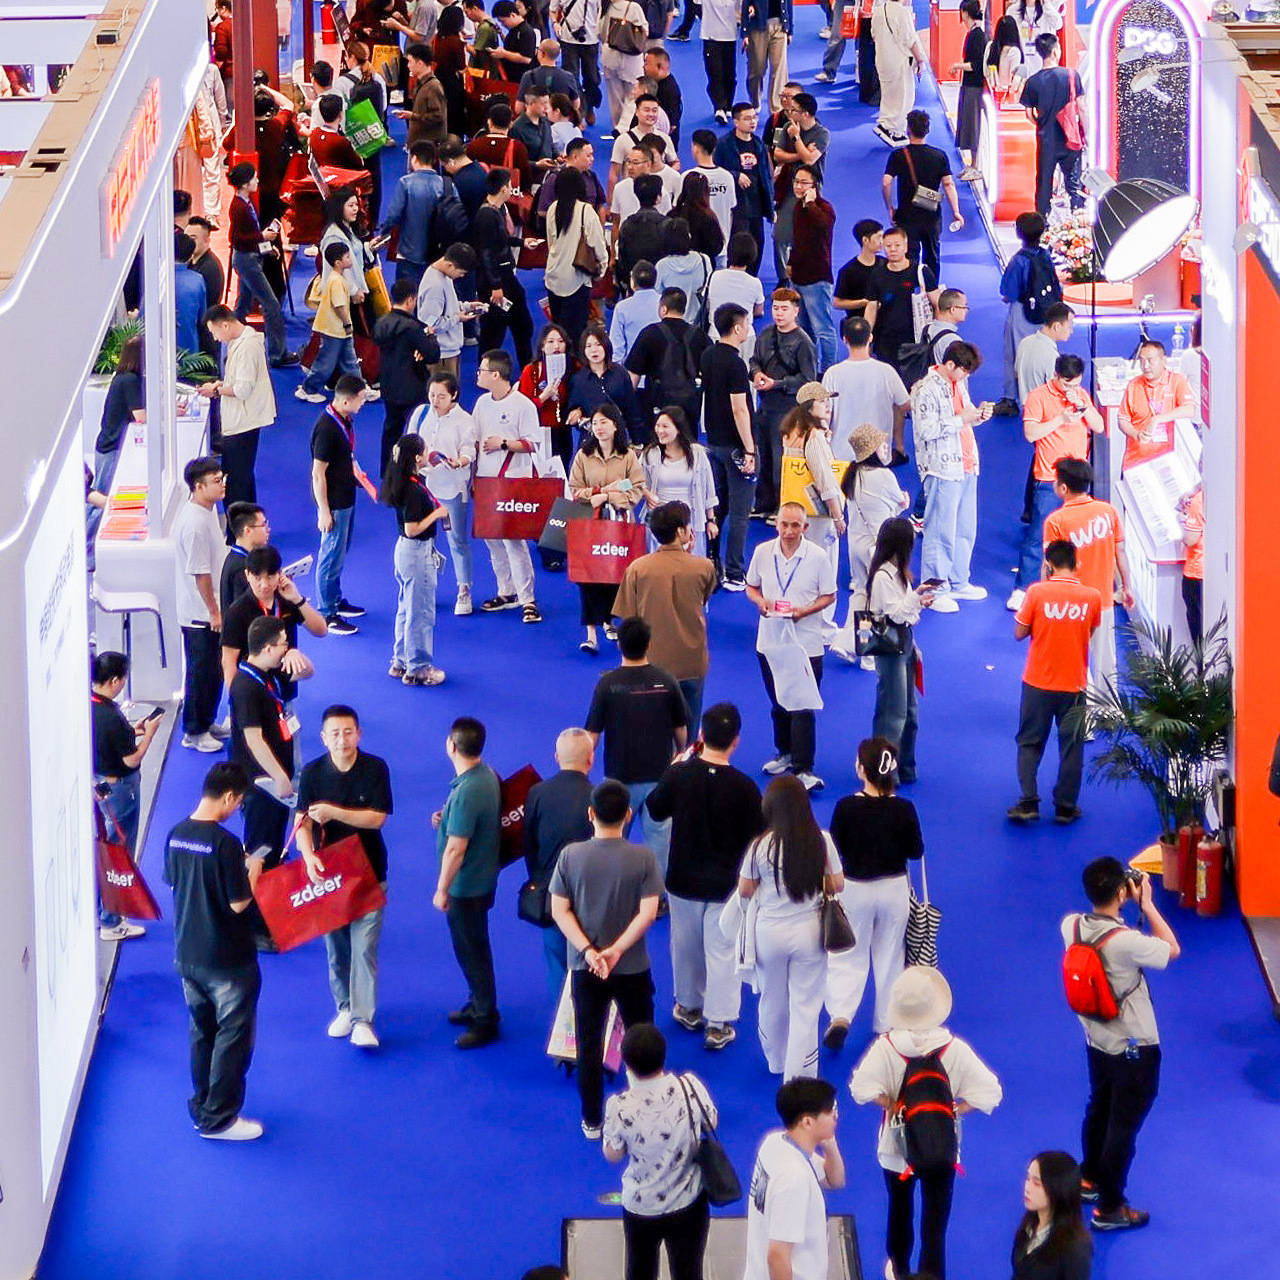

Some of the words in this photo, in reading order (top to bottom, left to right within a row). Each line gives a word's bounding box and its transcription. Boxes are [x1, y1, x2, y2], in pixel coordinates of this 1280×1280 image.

[496, 499, 539, 514] zdeer
[591, 542, 629, 557] zdeer
[290, 872, 344, 909] zdeer
